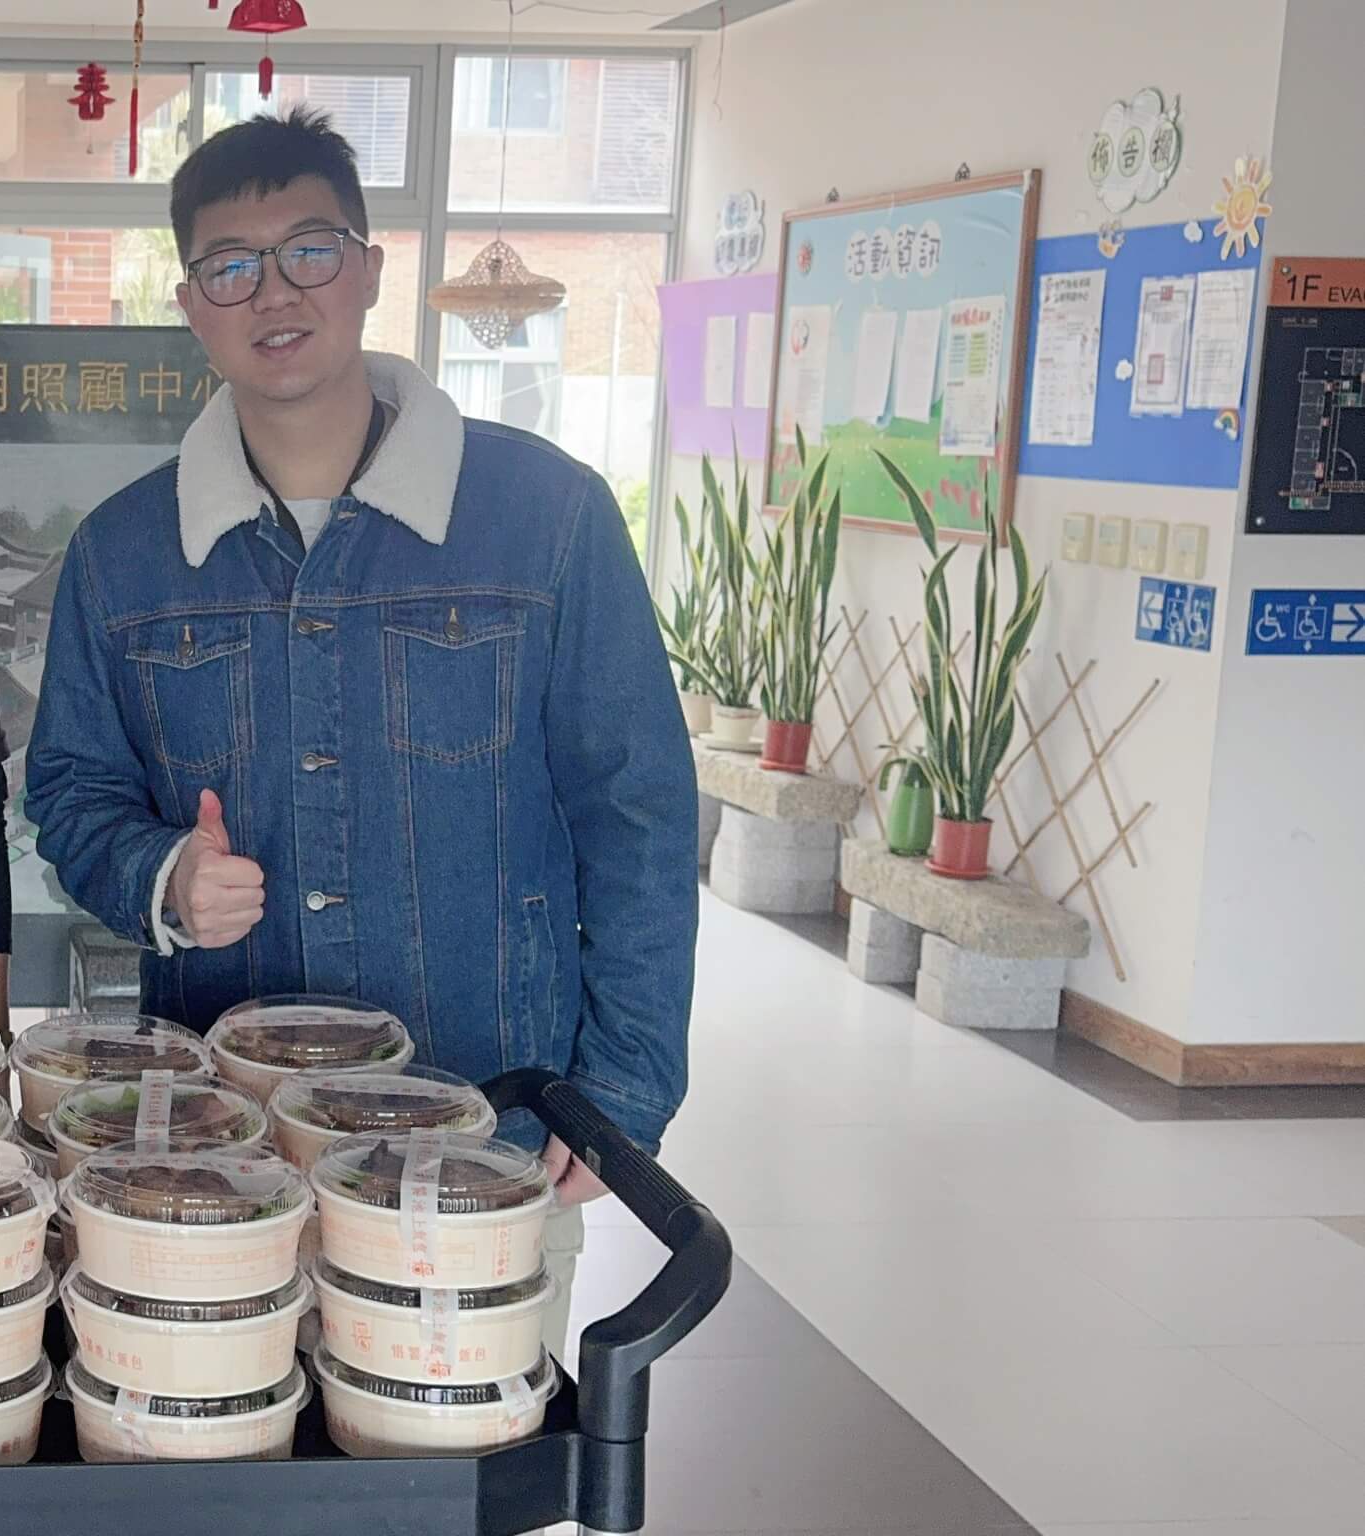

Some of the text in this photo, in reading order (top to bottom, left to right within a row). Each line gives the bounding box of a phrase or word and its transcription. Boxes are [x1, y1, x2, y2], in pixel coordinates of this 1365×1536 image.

[1091, 126, 1174, 174] 佈告欄
[847, 228, 942, 277] 活動資訊
[1287, 274, 1365, 303] 1F EVA
